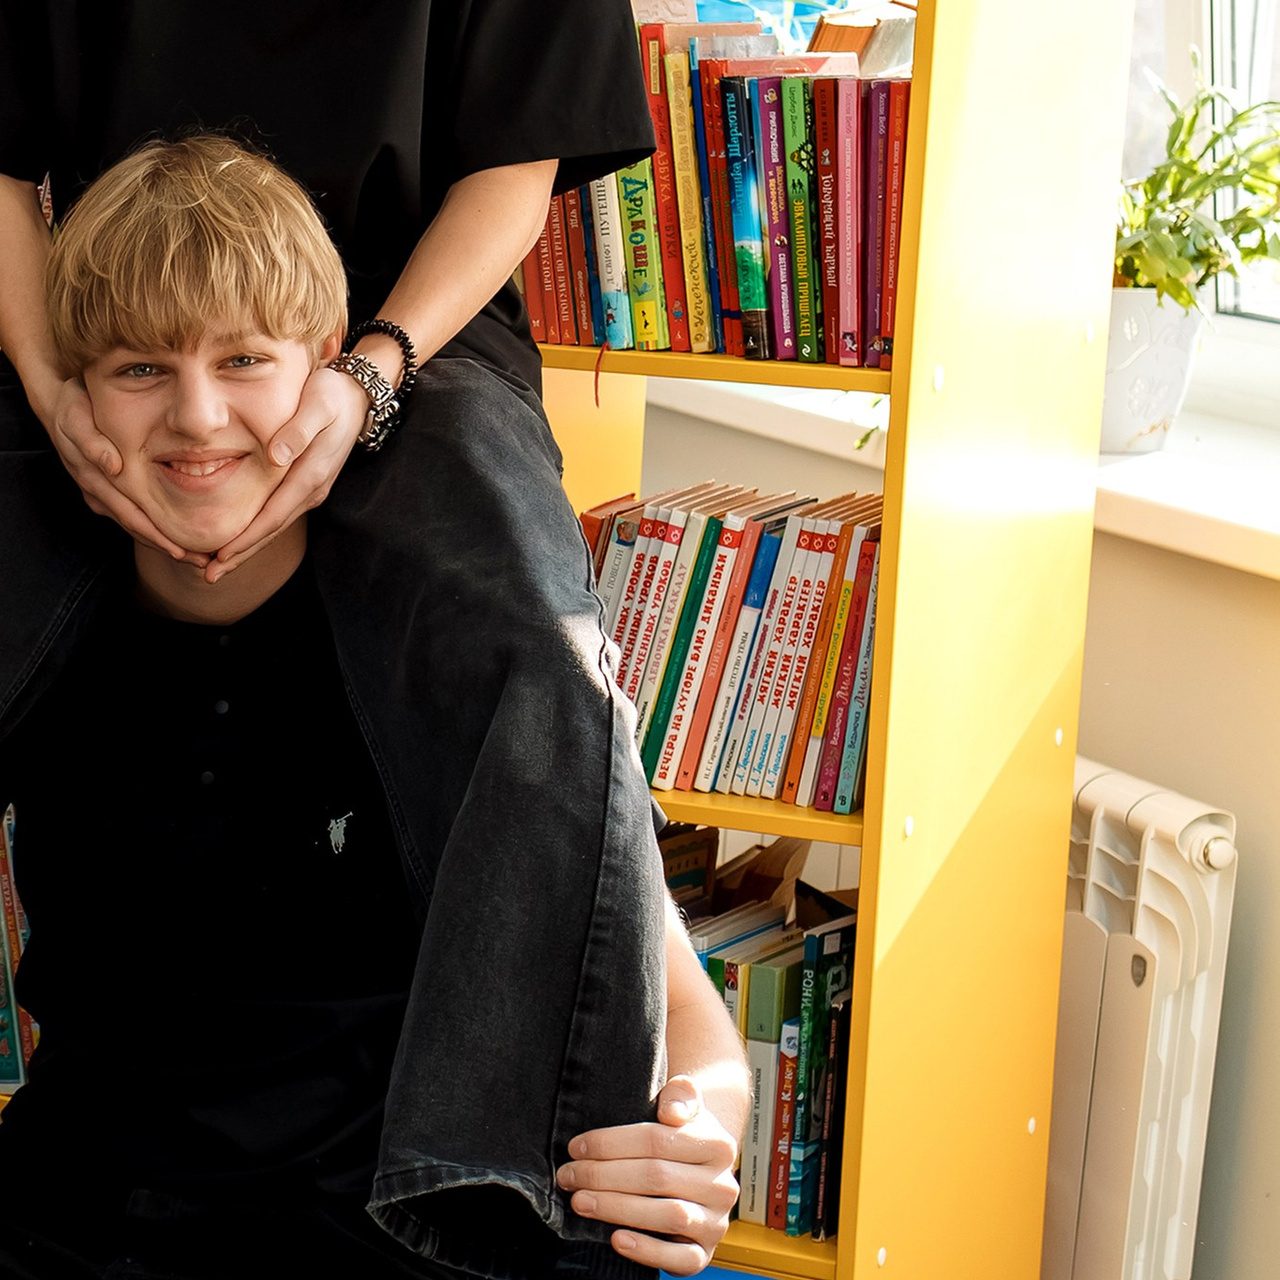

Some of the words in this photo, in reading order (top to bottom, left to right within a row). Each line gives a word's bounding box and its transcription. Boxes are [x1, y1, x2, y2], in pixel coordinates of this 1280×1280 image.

[556, 258, 566, 272] ПО
[793, 198, 808, 279] ЭВКАЛИПТОВЫЙ
[558, 275, 570, 322] ПРОГУЛКИ
[798, 282, 811, 337] ПРИШЕЛЕЦ
[623, 552, 646, 602] УРОКОВ
[756, 649, 778, 705] МЯГКИЙ
[772, 575, 798, 643] ХАРАКТЕР
[771, 654, 792, 709] МЯГКИЙ
[787, 579, 812, 648] ХАРАКТЕР
[786, 655, 808, 711] МЯГКИЙ
[801, 579, 826, 649] ХАРАКТЕР
